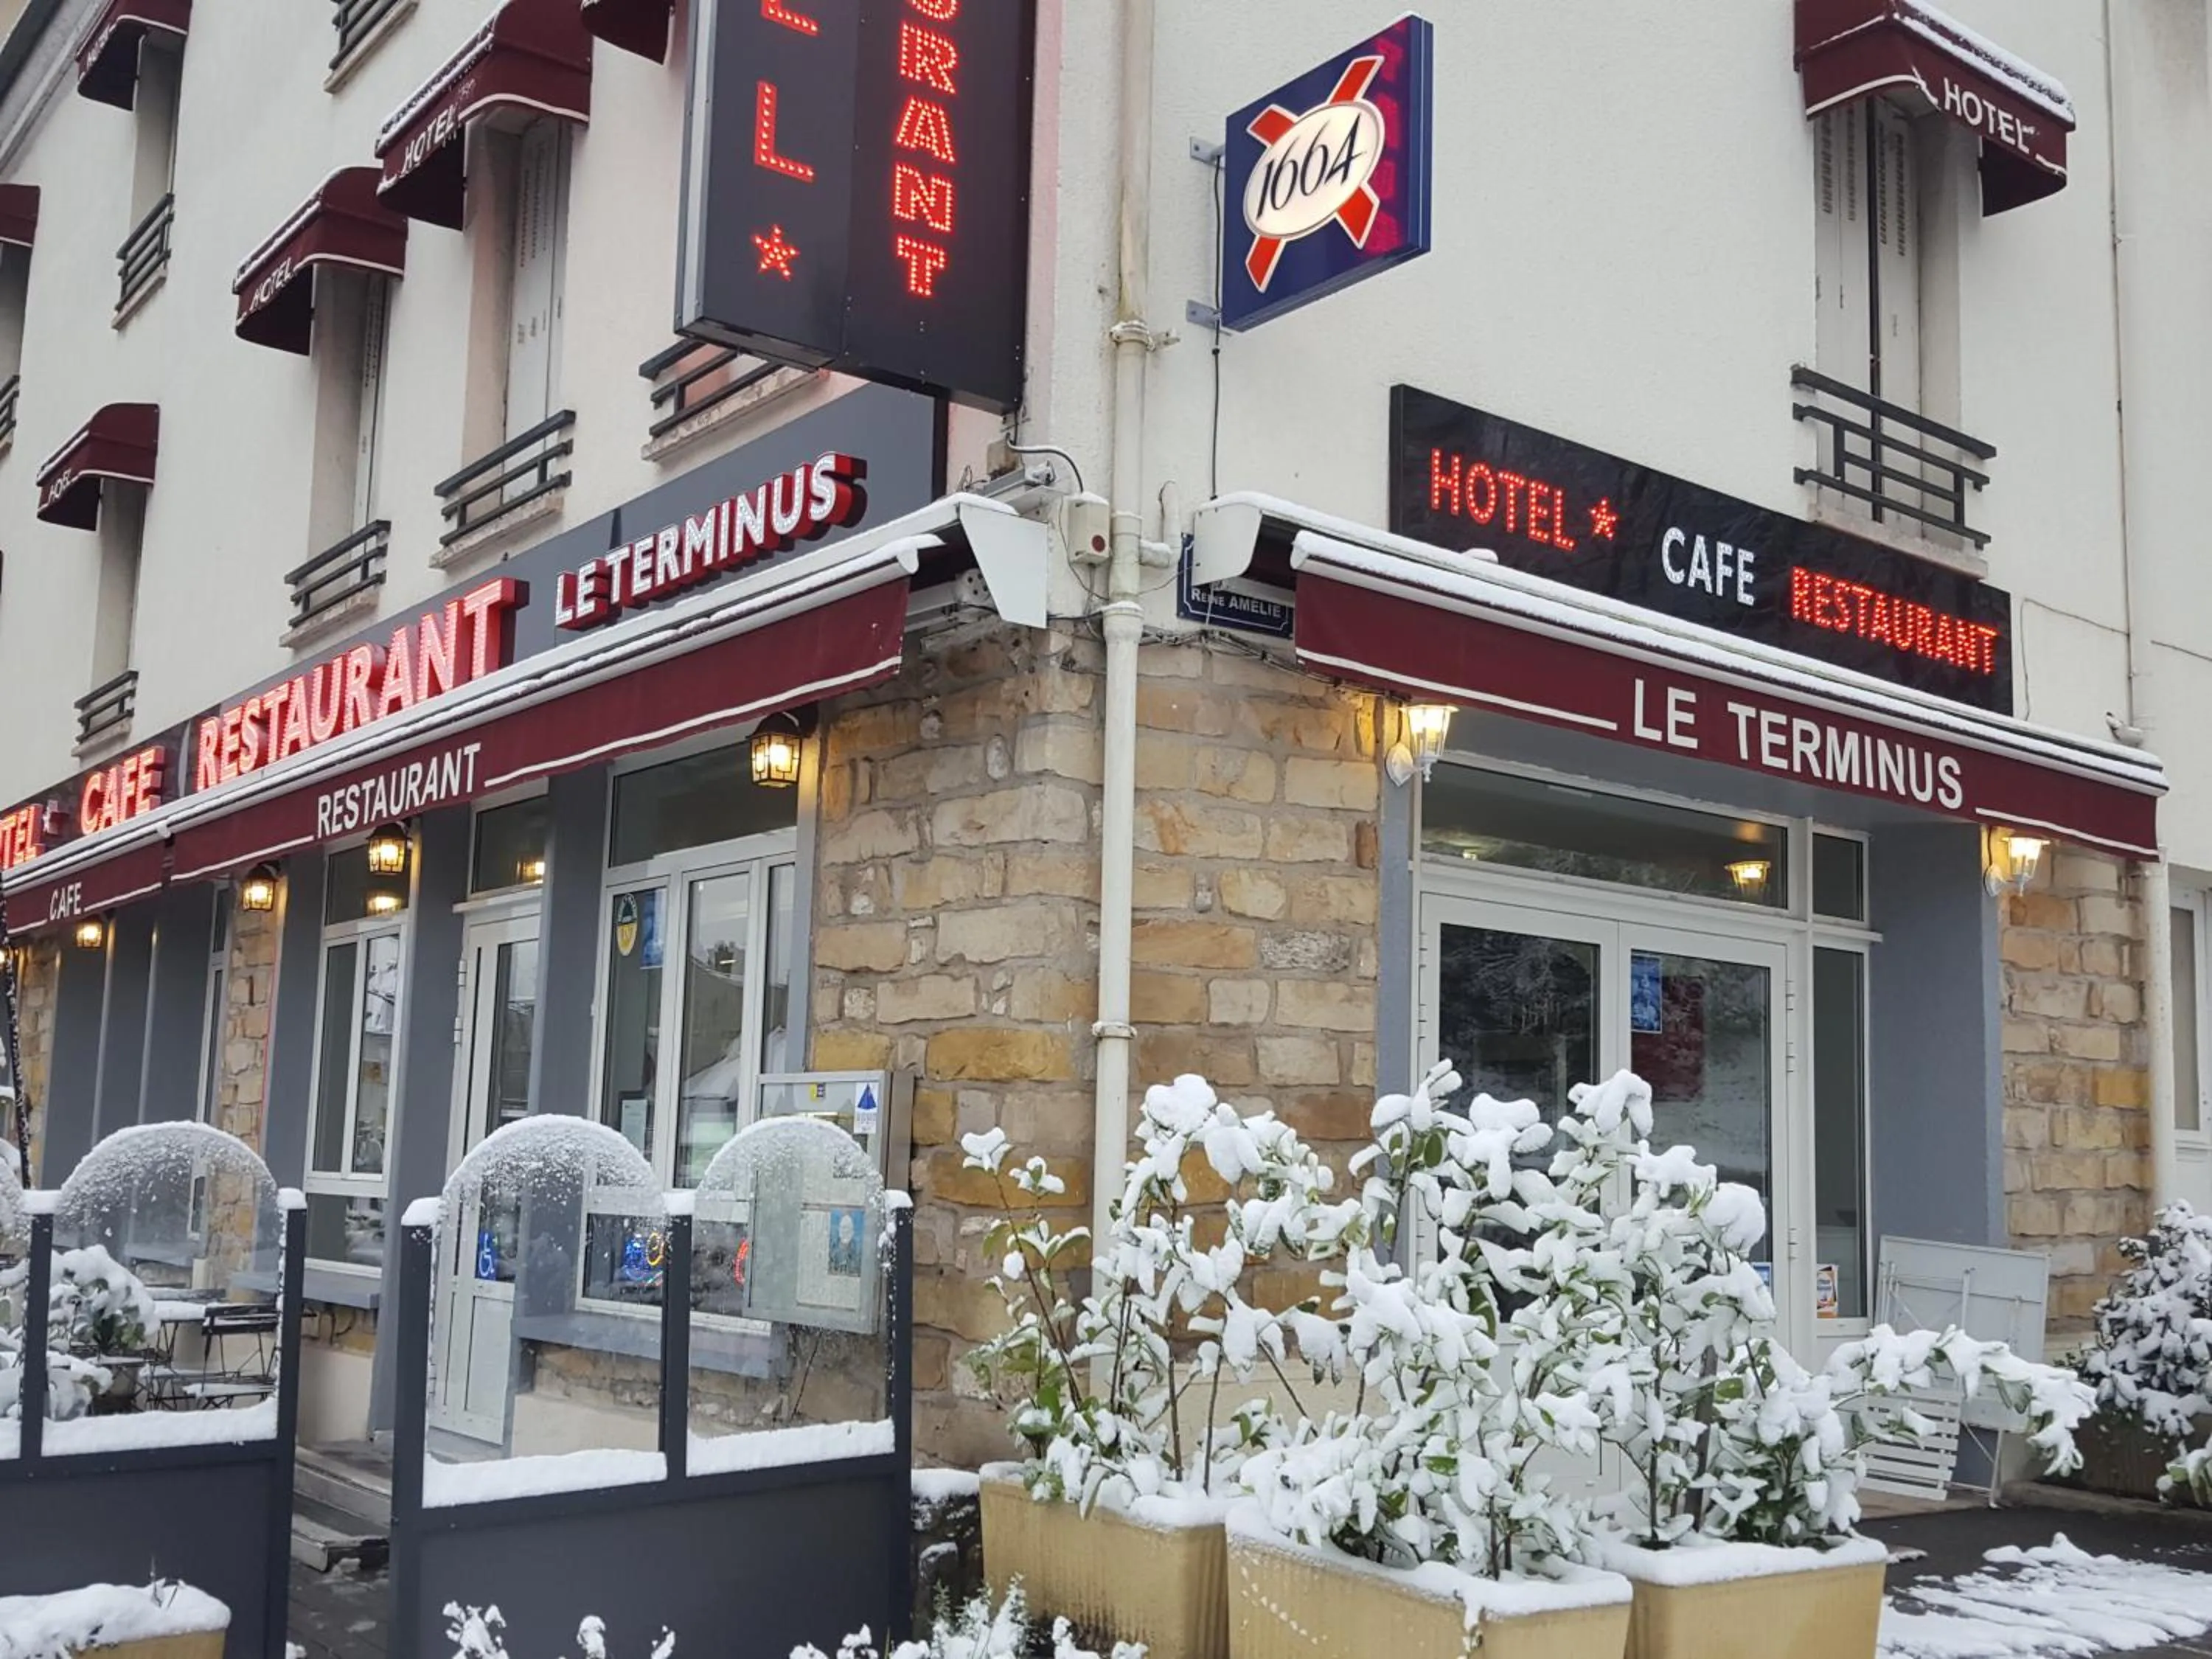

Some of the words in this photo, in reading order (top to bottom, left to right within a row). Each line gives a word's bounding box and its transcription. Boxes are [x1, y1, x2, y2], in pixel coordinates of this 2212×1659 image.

[400, 102, 456, 176] HOTEL
[1255, 111, 1365, 222] 1664
[1943, 76, 2031, 155] HOTEL
[606, 453, 844, 603] TERMINUS
[1430, 447, 1576, 553] HOTEL
[1228, 594, 1281, 618] AMELIE
[1660, 525, 1758, 608] CAFE
[1790, 565, 2000, 678] RESTAURANT
[0, 804, 42, 869] TEL
[80, 746, 162, 835] CAFE
[195, 577, 509, 793] RESTAURANT
[1632, 678, 1700, 750] LE
[1727, 700, 1964, 810] TERMINUS
[316, 742, 481, 838] RESTAURANT
[49, 882, 83, 922] CAFE
